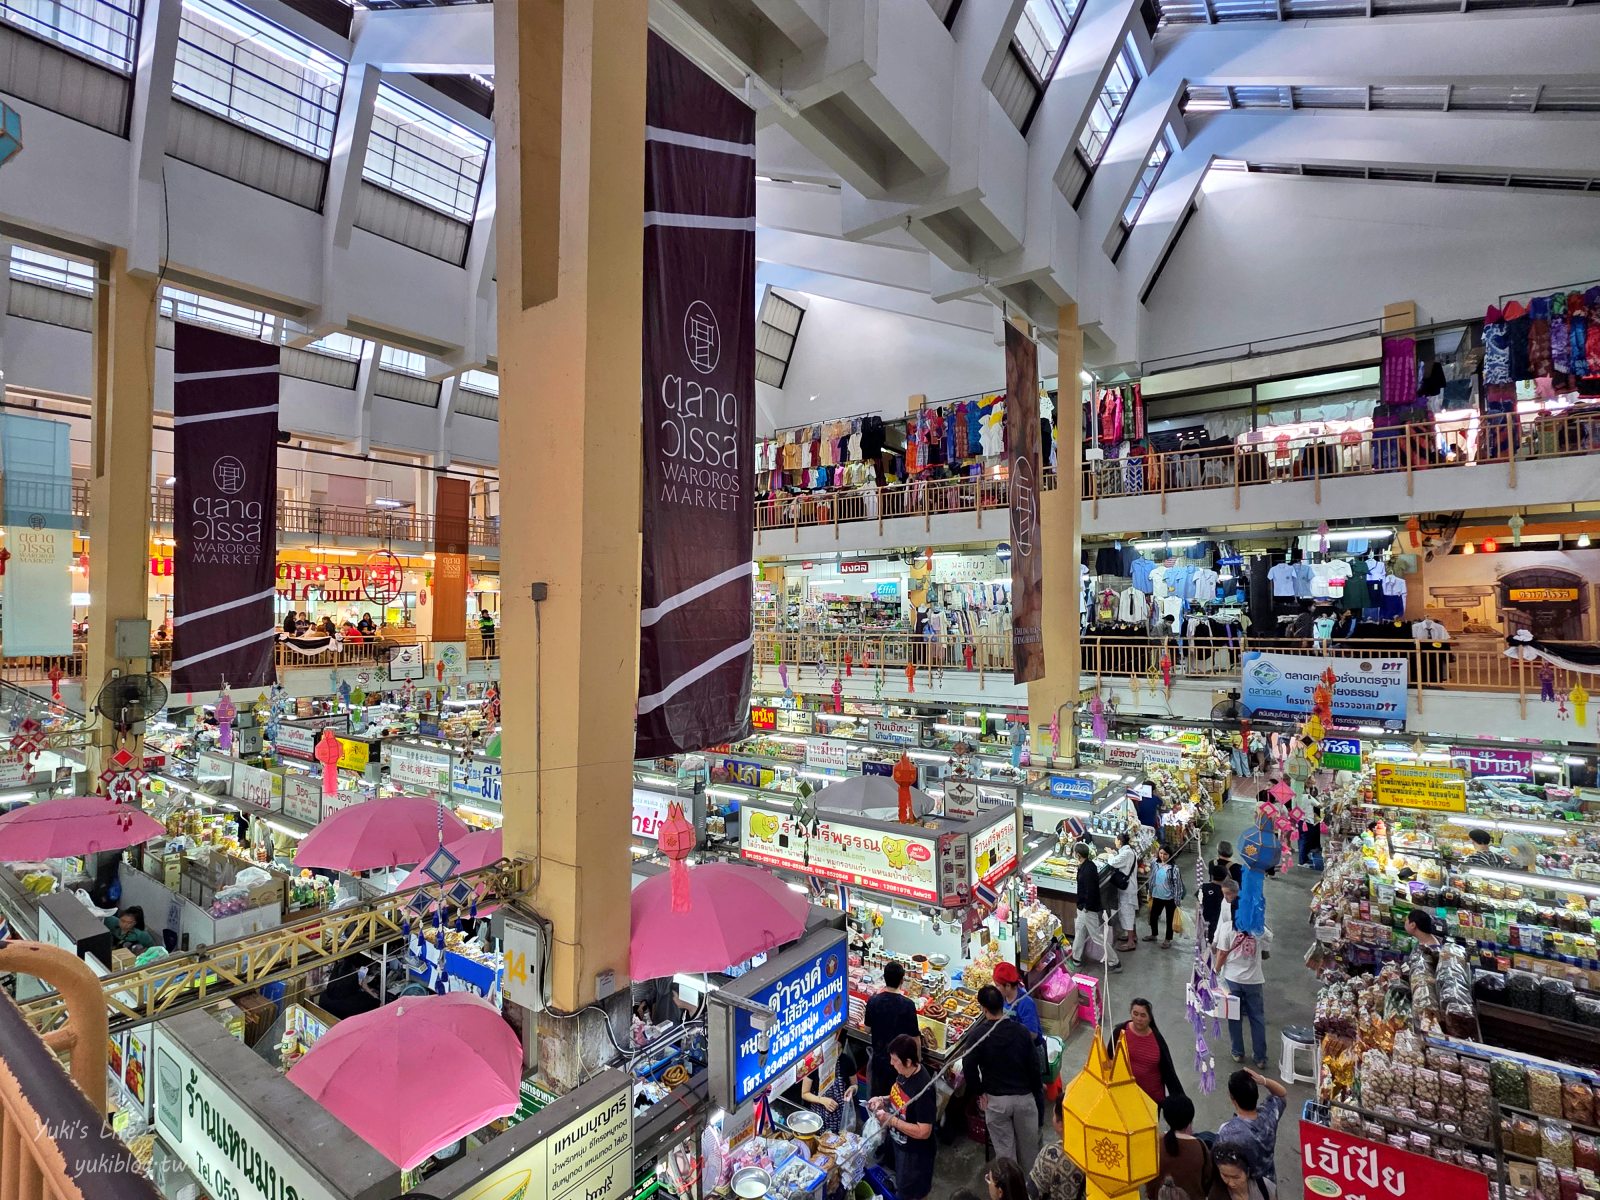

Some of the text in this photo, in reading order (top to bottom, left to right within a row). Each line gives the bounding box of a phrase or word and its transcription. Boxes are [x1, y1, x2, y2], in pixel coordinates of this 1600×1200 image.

[662, 374, 738, 428] ตลาด
[661, 413, 739, 470] วโรรส
[661, 461, 740, 492] WAROROS
[193, 497, 262, 519] ตลาด
[661, 484, 740, 511] MARKET
[192, 516, 261, 543] วโรรส
[192, 553, 261, 565] MARKET
[193, 541, 261, 555] WAROROS
[878, 584, 896, 594] Effin
[505, 949, 528, 987] 14
[554, 1093, 627, 1156] แหนมบุญศรี
